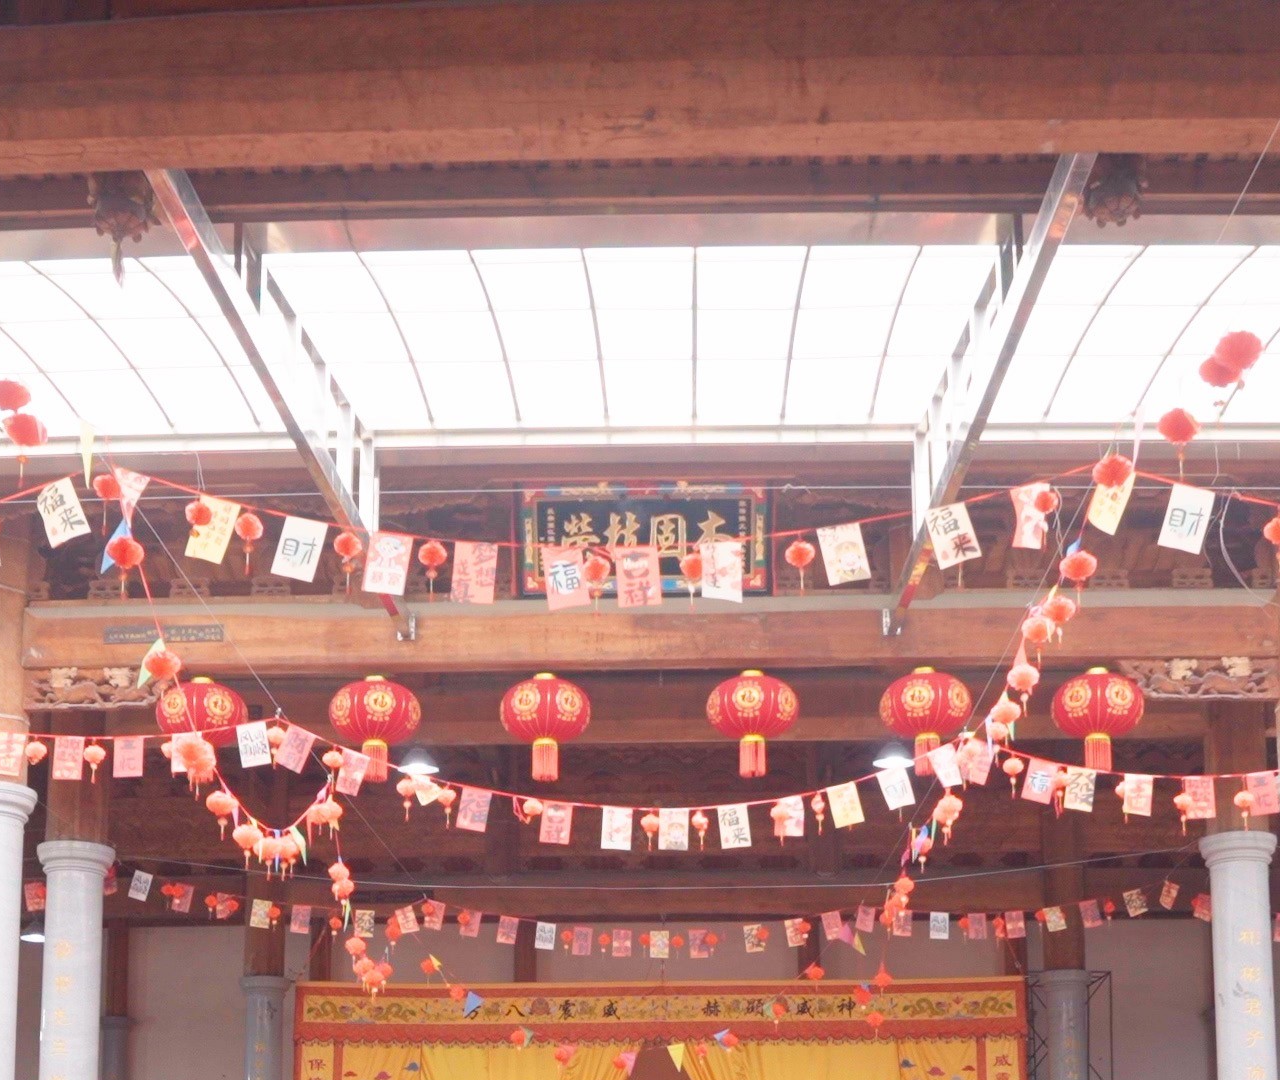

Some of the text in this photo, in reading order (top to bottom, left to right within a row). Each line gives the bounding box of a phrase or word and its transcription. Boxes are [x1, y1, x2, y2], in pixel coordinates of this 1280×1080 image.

[39, 484, 86, 531] 福来
[930, 508, 980, 560] 福来
[549, 561, 581, 593] 福
[719, 808, 749, 844] 福来
